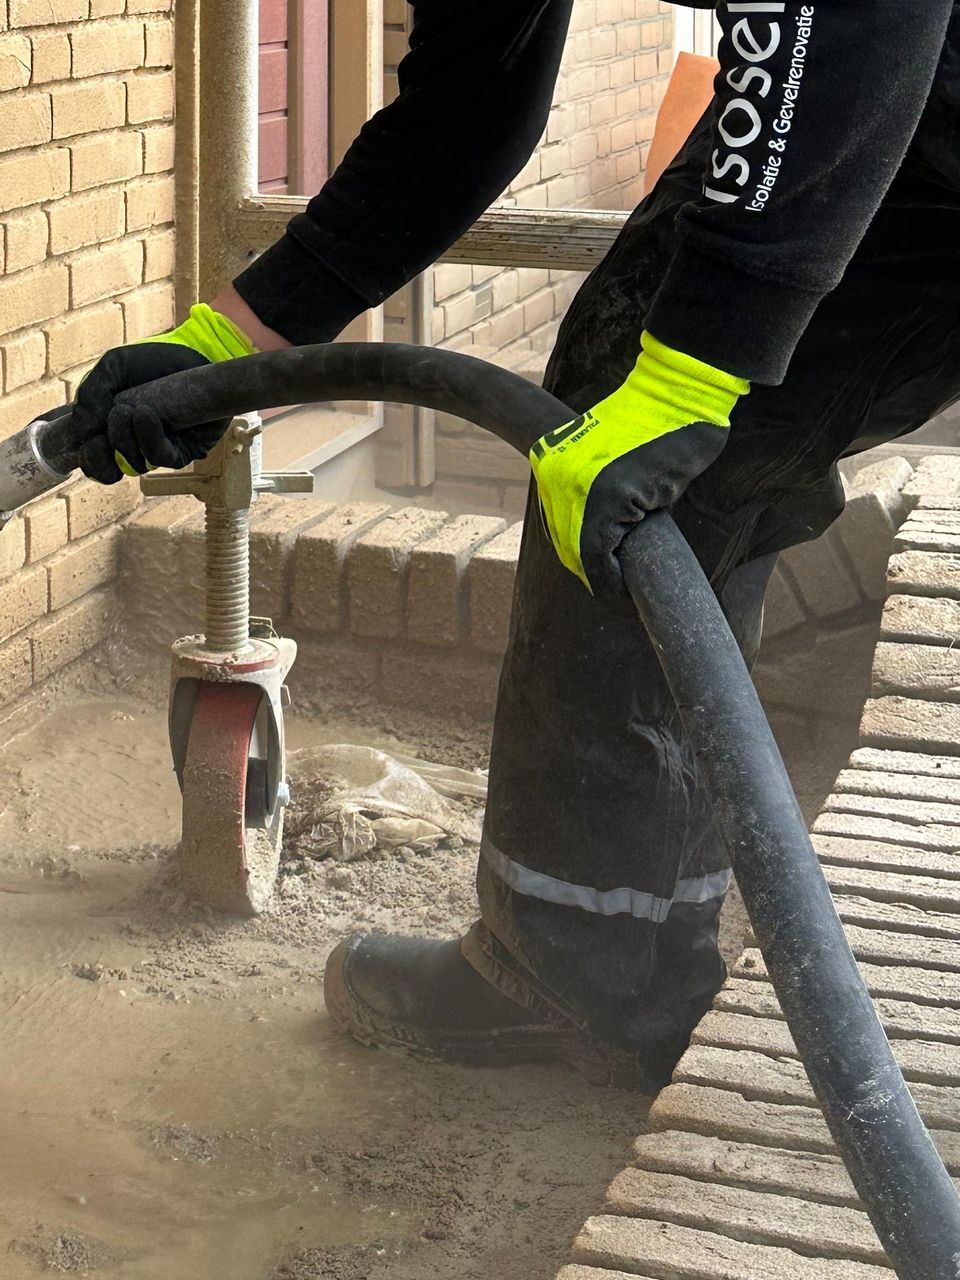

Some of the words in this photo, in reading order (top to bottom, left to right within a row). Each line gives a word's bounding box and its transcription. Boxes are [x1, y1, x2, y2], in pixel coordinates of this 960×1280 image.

[772, 5, 815, 134] Gevelrenovatie
[768, 138, 787, 152] &
[745, 155, 782, 212] Isolatie
